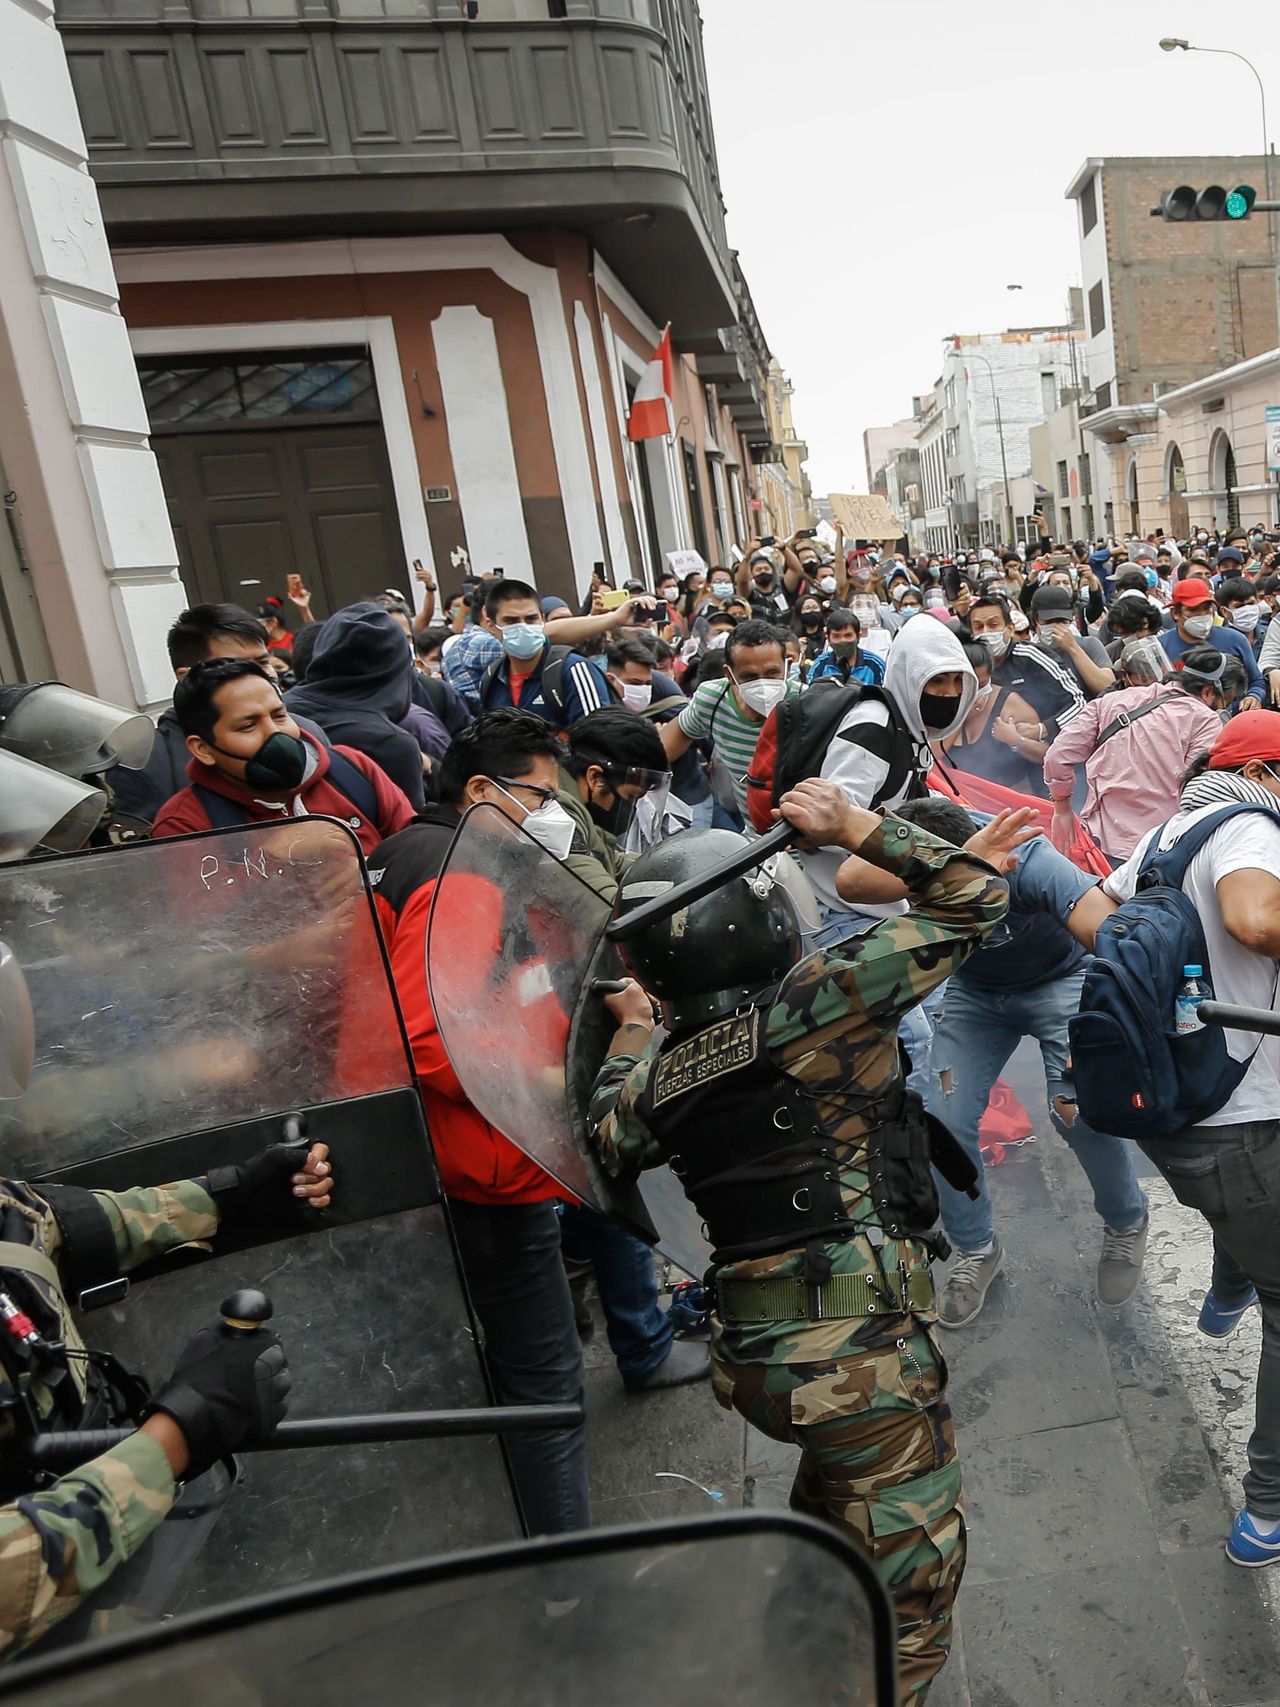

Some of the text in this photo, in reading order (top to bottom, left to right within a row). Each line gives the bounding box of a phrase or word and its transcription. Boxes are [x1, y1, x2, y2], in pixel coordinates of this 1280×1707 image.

[657, 1019, 750, 1083] POLICIA
[657, 1043, 750, 1100] FUERZAS ESPECIALES
